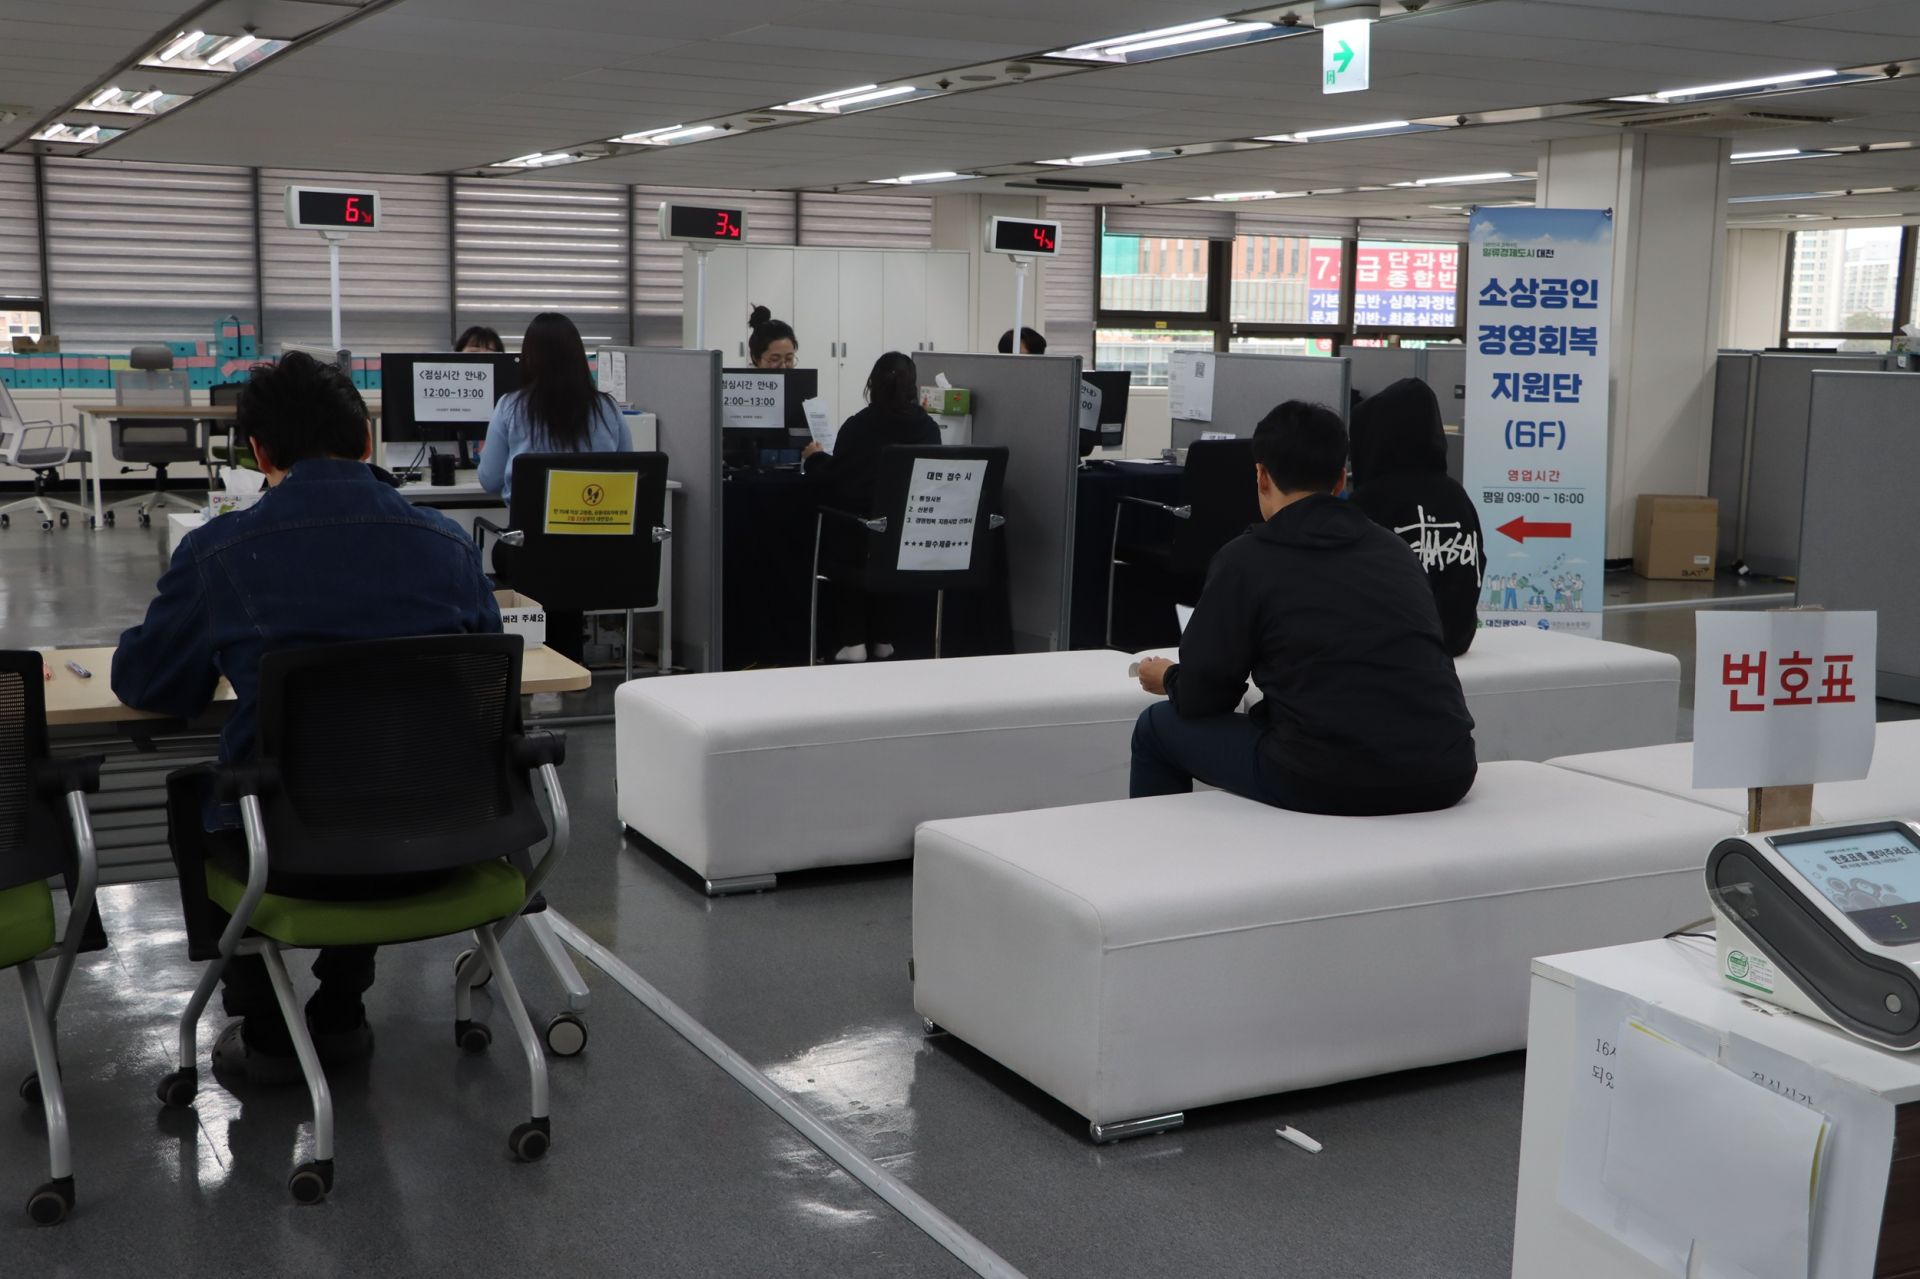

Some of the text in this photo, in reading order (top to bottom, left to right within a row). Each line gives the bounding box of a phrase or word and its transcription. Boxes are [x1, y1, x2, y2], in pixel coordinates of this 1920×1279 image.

[346, 197, 359, 222] 6
[715, 212, 729, 236] 3
[1033, 228, 1046, 247] 4
[1536, 249, 1554, 259] 대전
[1478, 277, 1599, 309] 소상공인
[1478, 325, 1598, 357] 경영회복
[419, 370, 487, 381] <점심시간 안내>
[757, 381, 778, 391] 안내>
[1491, 372, 1583, 404] 지원단
[724, 396, 775, 406] 2:00~13:00
[1504, 420, 1566, 450] (6F)
[926, 471, 972, 481] 대면 접수 시
[1507, 470, 1561, 482] 영업시간
[1483, 491, 1504, 504] 평일
[1506, 492, 1540, 504] 09:00
[1554, 493, 1585, 504] 16:00
[502, 614, 545, 624] 버려 주세요
[1722, 650, 1856, 712] 번호표
